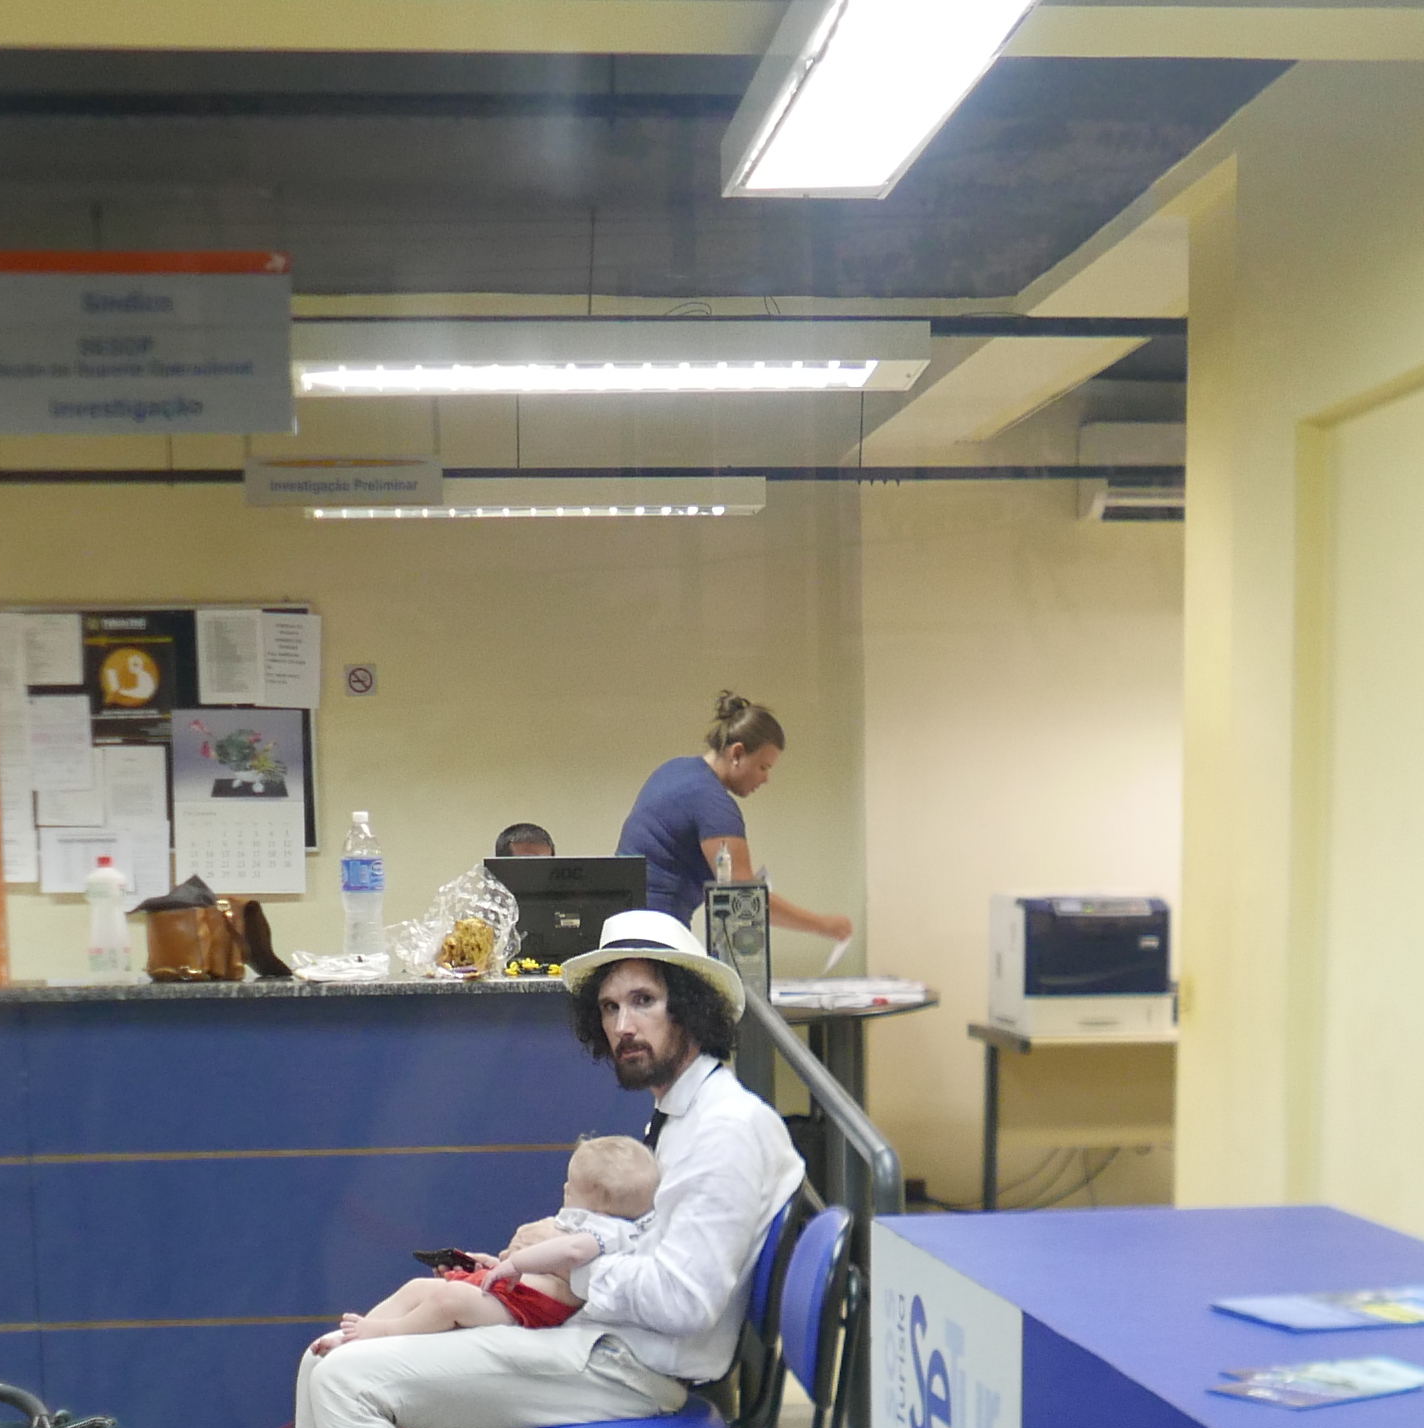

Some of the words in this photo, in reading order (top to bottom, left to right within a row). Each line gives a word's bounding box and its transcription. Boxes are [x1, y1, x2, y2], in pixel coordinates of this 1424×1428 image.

[270, 478, 349, 494] Investigação
[354, 478, 418, 492] Preliminar
[896, 1293, 906, 1424] Turista
